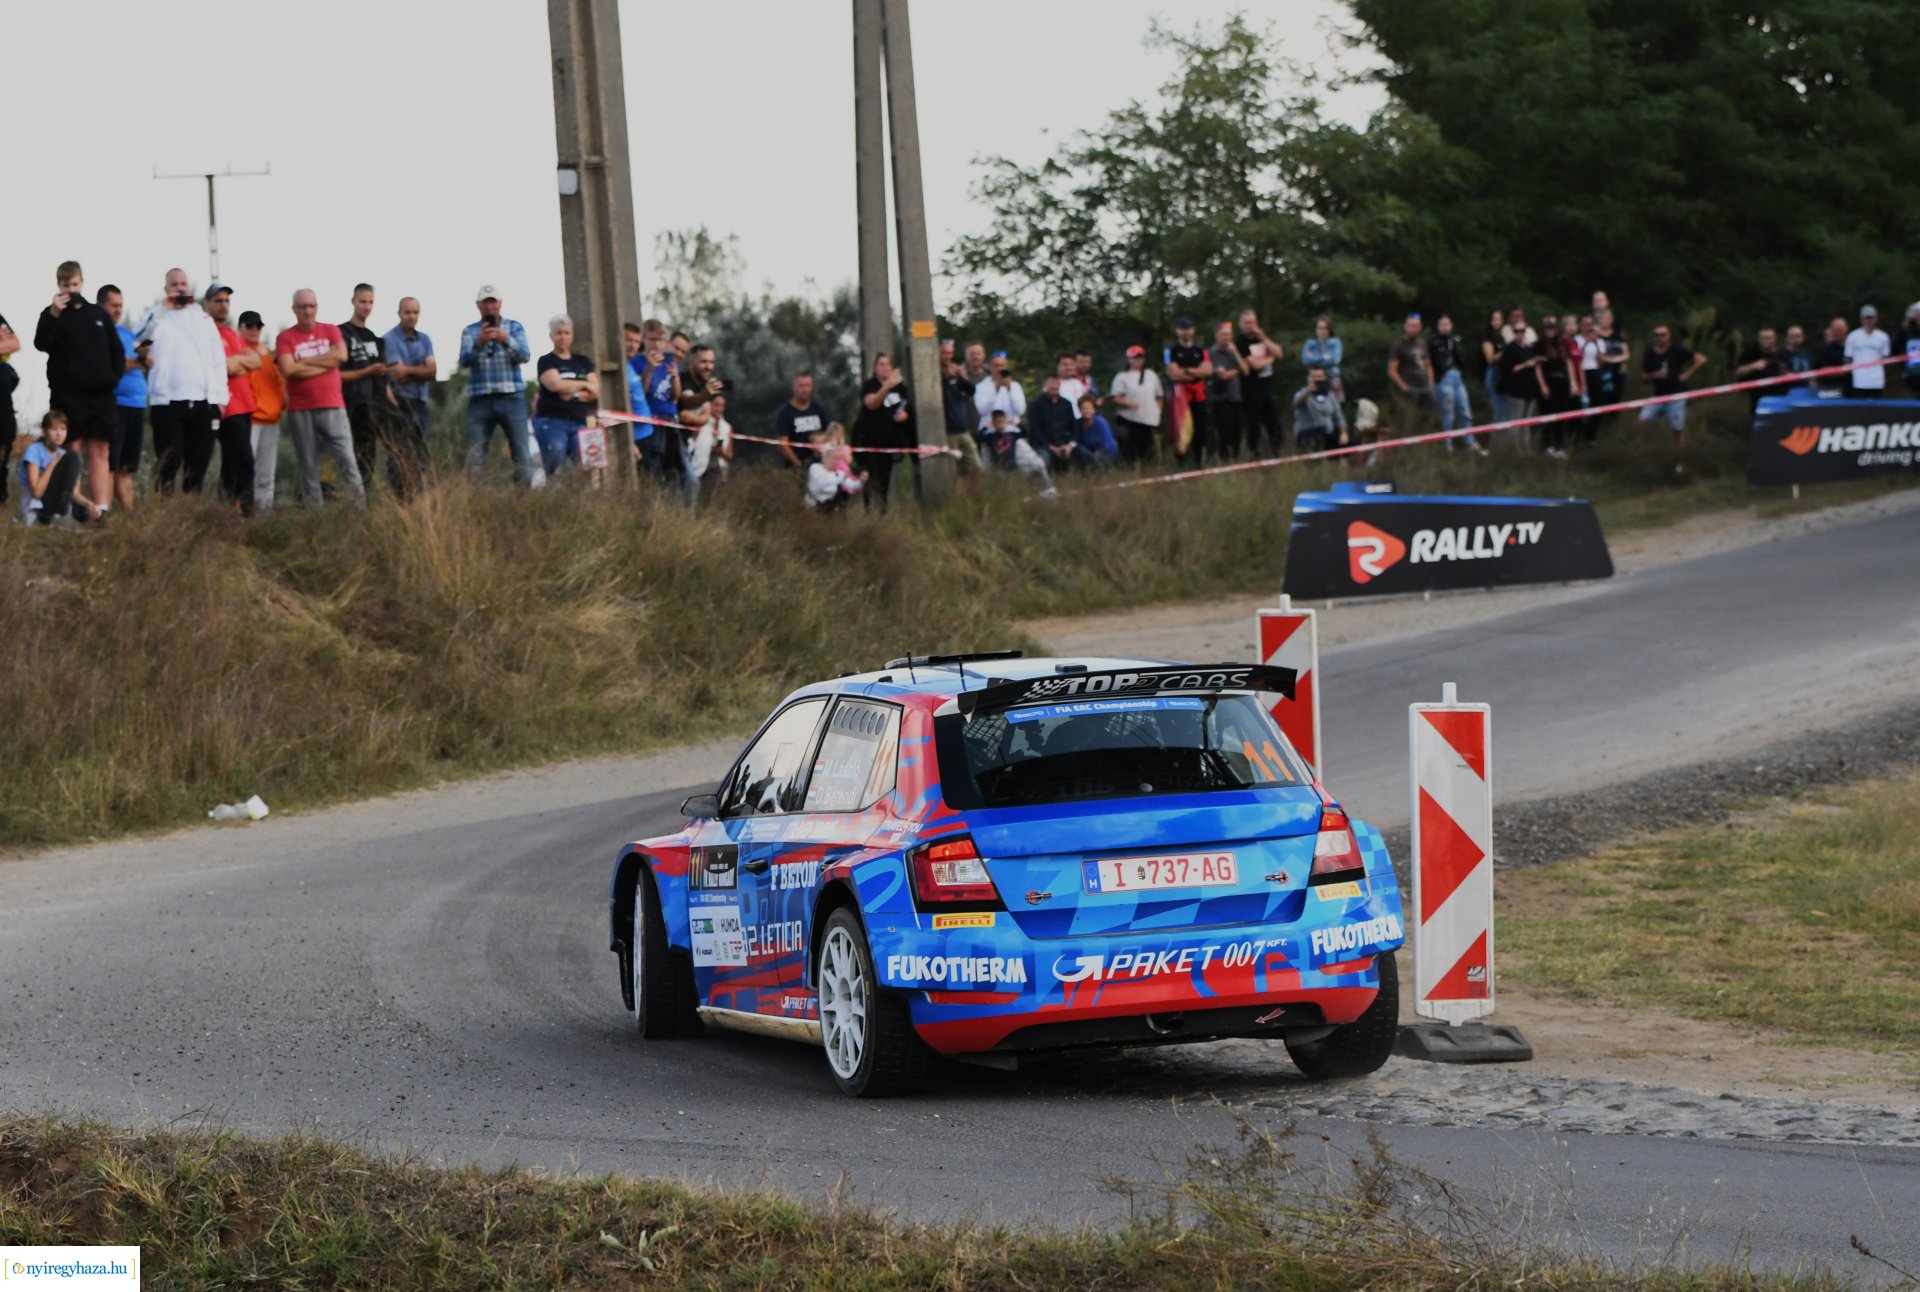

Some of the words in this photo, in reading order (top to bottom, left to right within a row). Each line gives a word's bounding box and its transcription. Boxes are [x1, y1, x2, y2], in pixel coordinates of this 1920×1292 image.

[1066, 673, 1140, 695] TOP
[1055, 703, 1071, 713] FIA
[1094, 699, 1157, 710] Championship
[869, 739, 897, 797] 11
[1242, 740, 1296, 782] 11
[780, 861, 818, 889] BETON
[1089, 879, 1098, 889] H
[1114, 862, 1126, 888] I
[935, 914, 991, 928] PIRELLI
[1311, 915, 1403, 955] FUKOTHERM
[761, 920, 802, 955] LETICIA
[887, 955, 1027, 983] FUKOTHERM
[1107, 945, 1221, 979] PAKET
[1223, 941, 1265, 969] 007
[1266, 938, 1287, 948] KFT.
